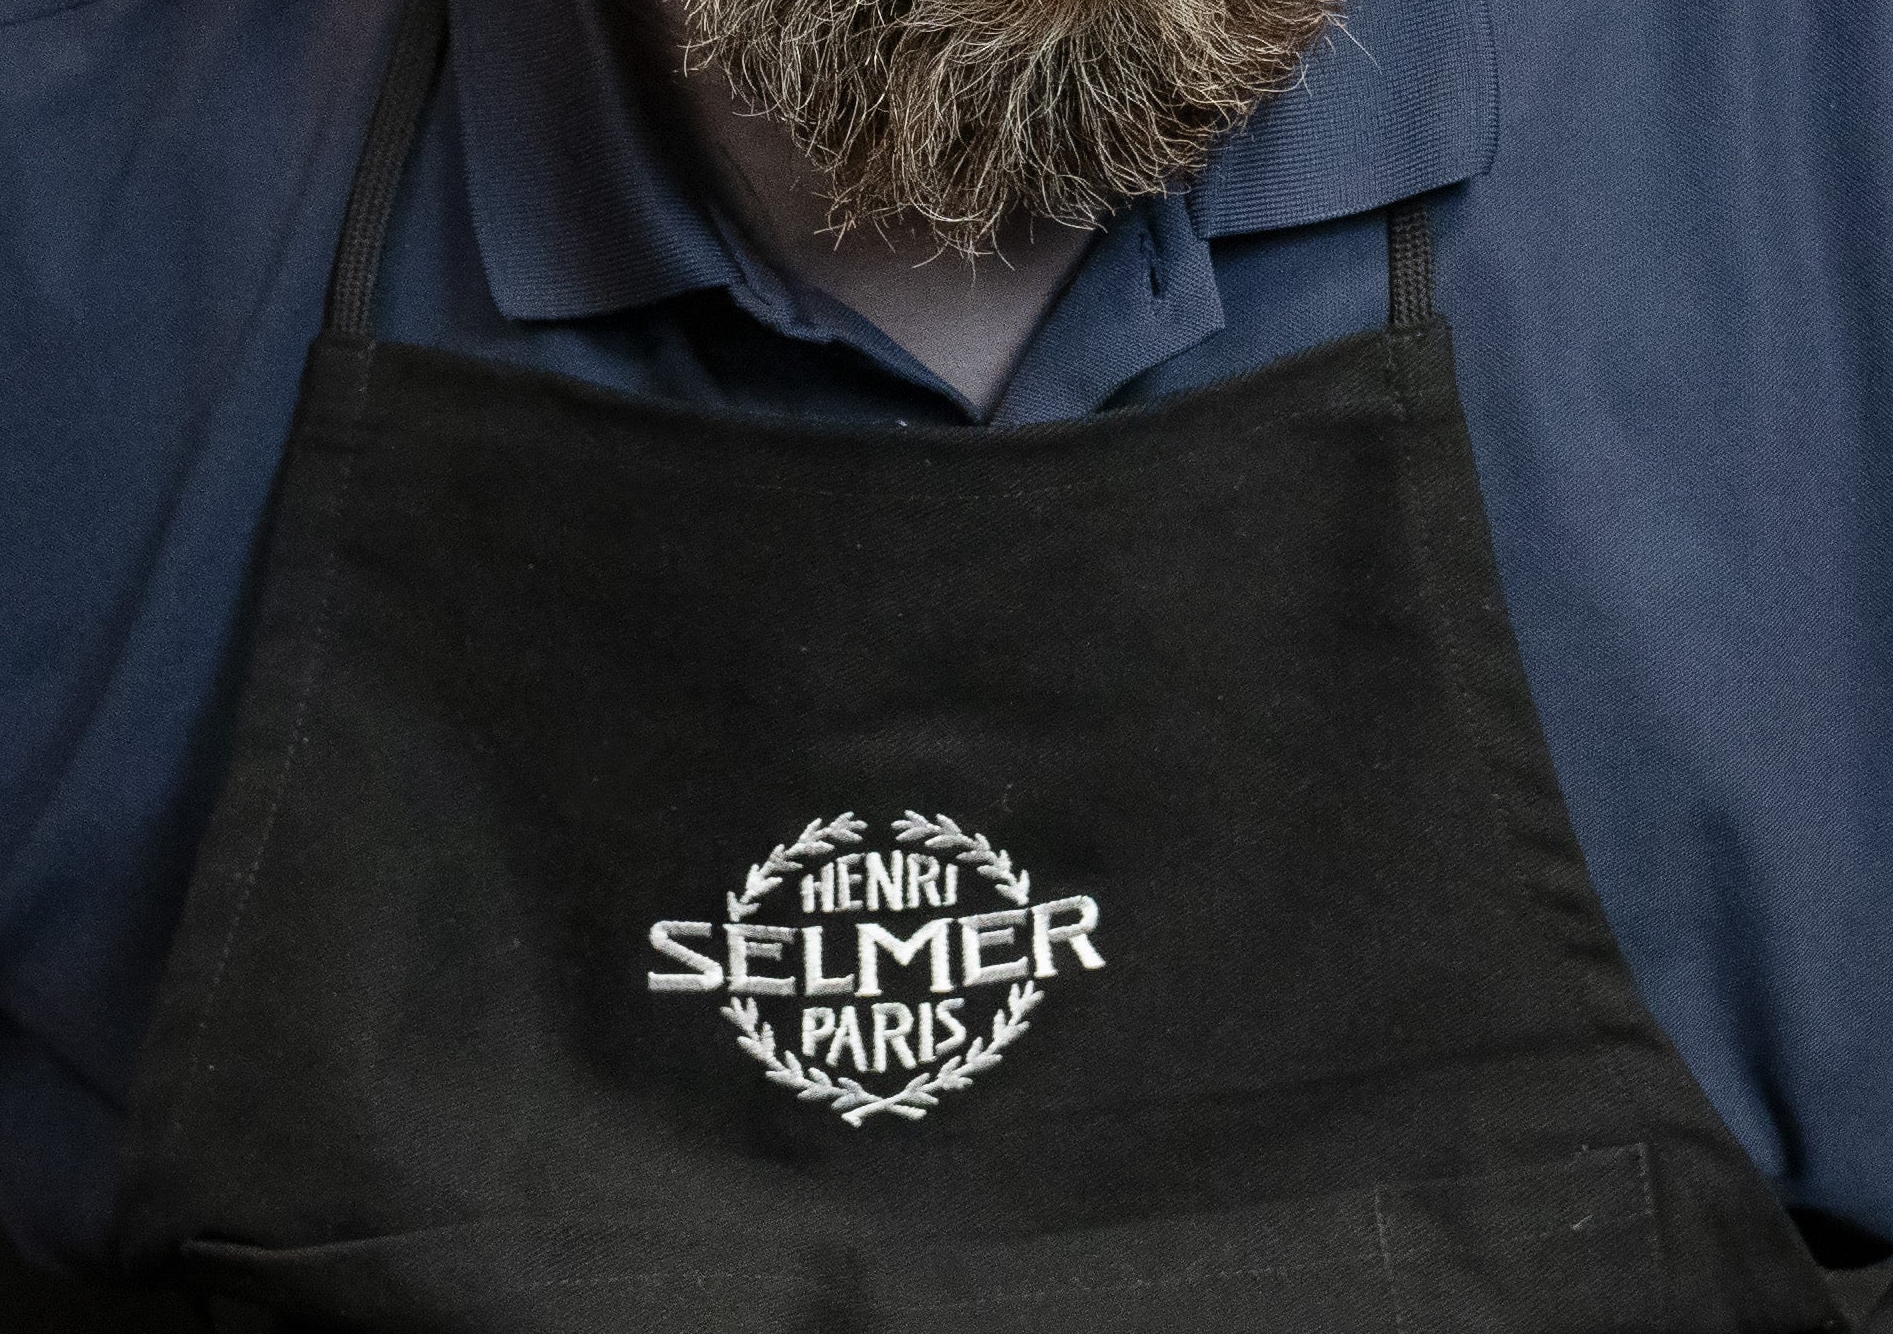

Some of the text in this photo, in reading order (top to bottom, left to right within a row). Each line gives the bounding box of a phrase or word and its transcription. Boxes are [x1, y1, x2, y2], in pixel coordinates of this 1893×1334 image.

[800, 850, 958, 913] HENRI
[648, 895, 1106, 997] SELMER
[801, 998, 966, 1073] PARIS
